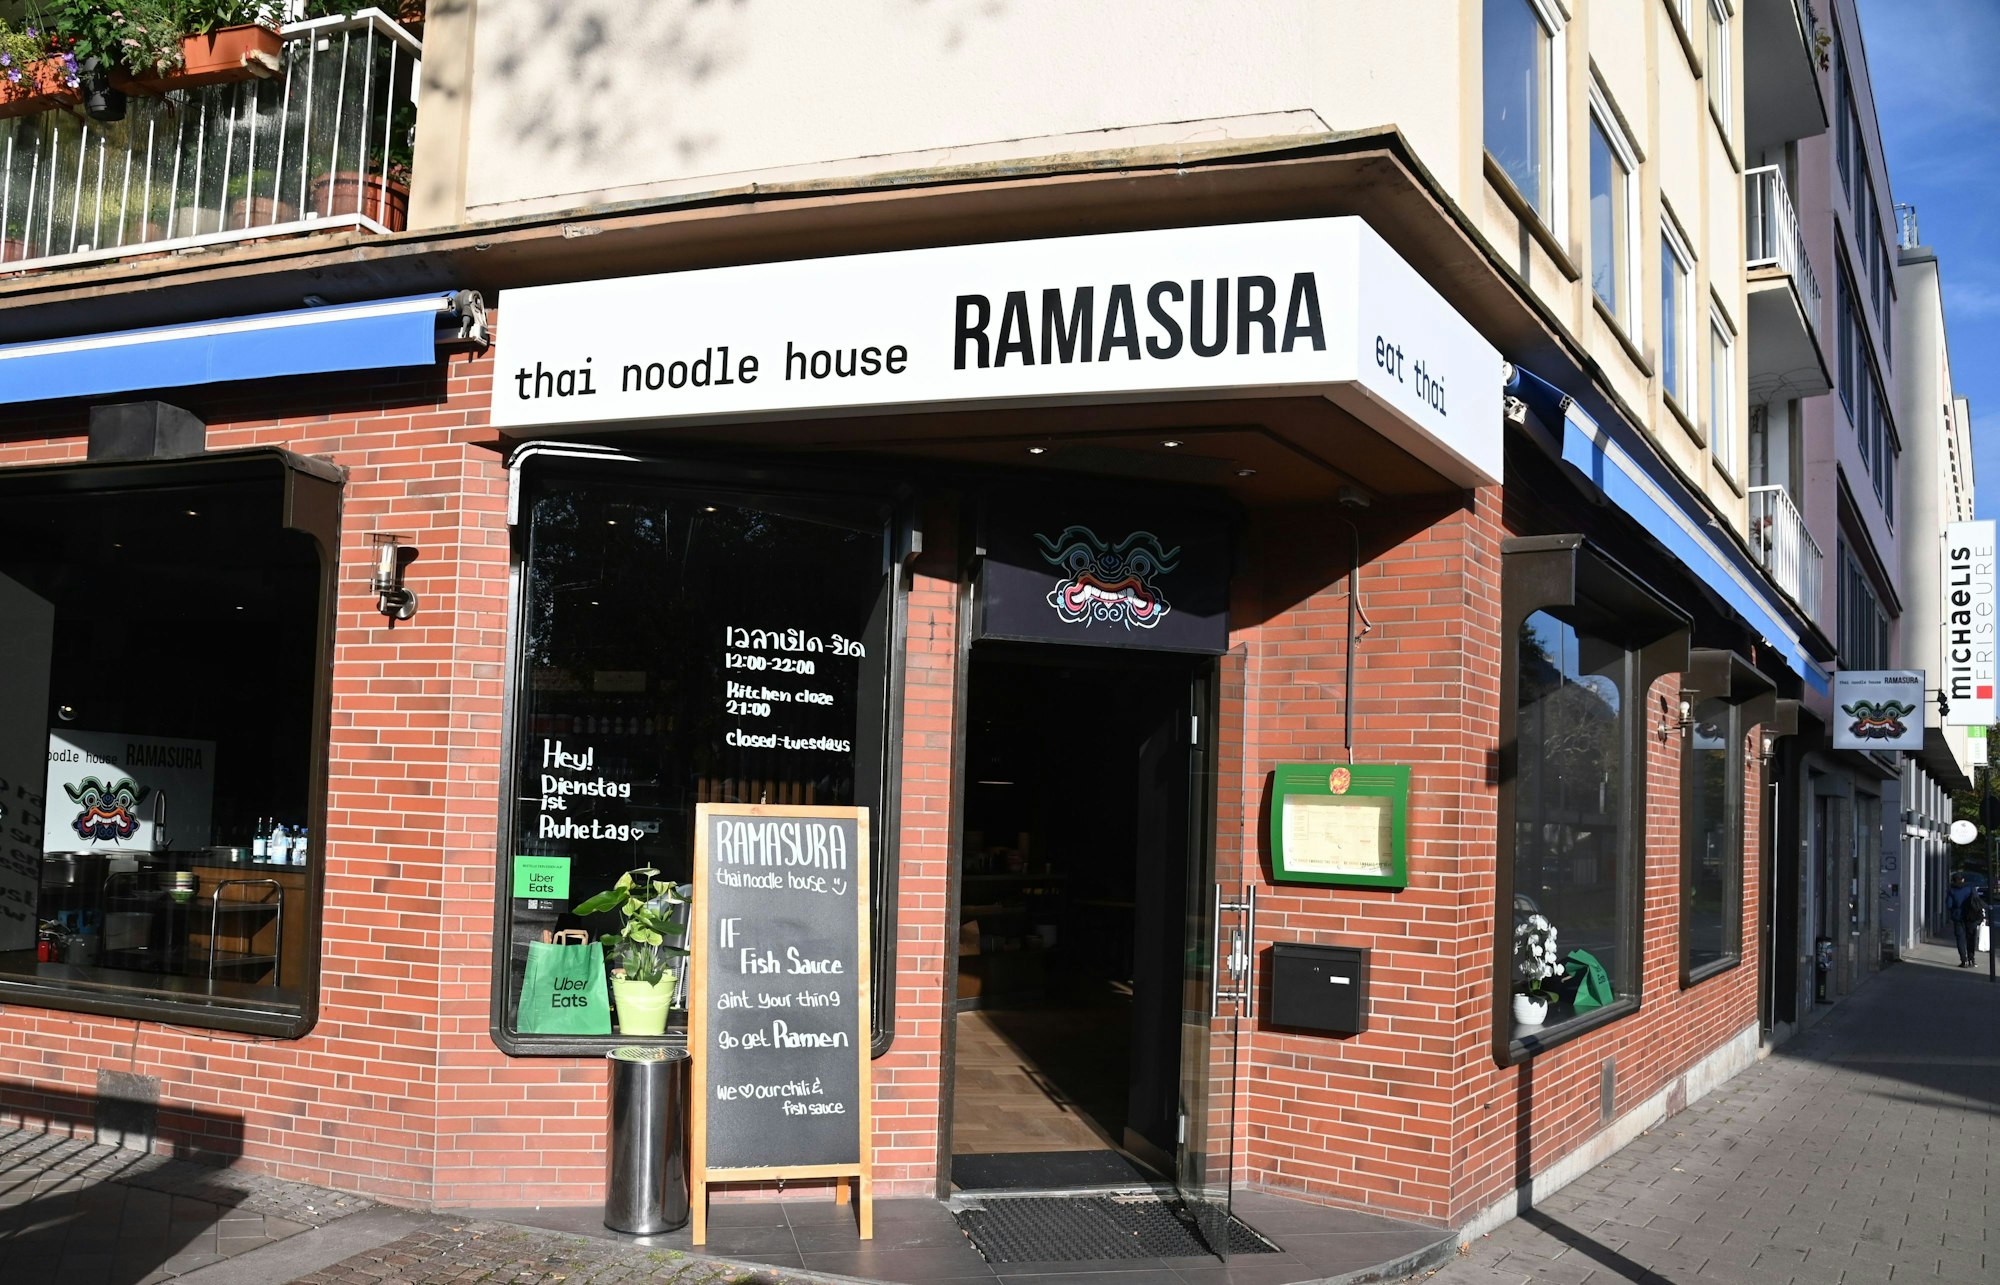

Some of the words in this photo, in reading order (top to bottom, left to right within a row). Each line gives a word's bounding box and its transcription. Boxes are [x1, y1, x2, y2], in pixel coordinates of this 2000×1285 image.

[514, 356, 597, 400] thai
[621, 345, 760, 392] noodle
[784, 341, 908, 381] house
[953, 271, 1327, 370] RAMASURA
[1375, 335, 1404, 384] eat
[1413, 359, 1447, 417] thai
[725, 652, 816, 675] 12:00-22:00
[726, 680, 792, 702] Kitchen
[1884, 676, 1919, 684] RAMASURA
[725, 700, 771, 718] 21:00
[47, 749, 79, 762] oodle
[85, 750, 118, 765] house
[126, 743, 203, 769] RAMASURA
[542, 738, 594, 771] Hey!
[541, 774, 631, 798] Dienstag
[540, 794, 568, 811] ist
[539, 814, 630, 841] Ruhetag
[716, 820, 847, 869] RAMASURA
[528, 883, 554, 893] Eats
[529, 872, 555, 883] Uber
[788, 871, 828, 893] house
[720, 917, 742, 948] IF
[740, 947, 781, 974] Fish
[786, 946, 845, 975] Sauce
[553, 976, 589, 991] Uber
[551, 993, 588, 1008] Eats
[717, 989, 754, 1010] aint
[758, 992, 792, 1009] your
[796, 990, 841, 1008] thing
[718, 1030, 740, 1050] go
[741, 1028, 771, 1050] get
[772, 1019, 849, 1049] Ramen
[755, 1085, 781, 1100] our
[782, 1100, 808, 1117] fish
[810, 1101, 846, 1115] sauce
